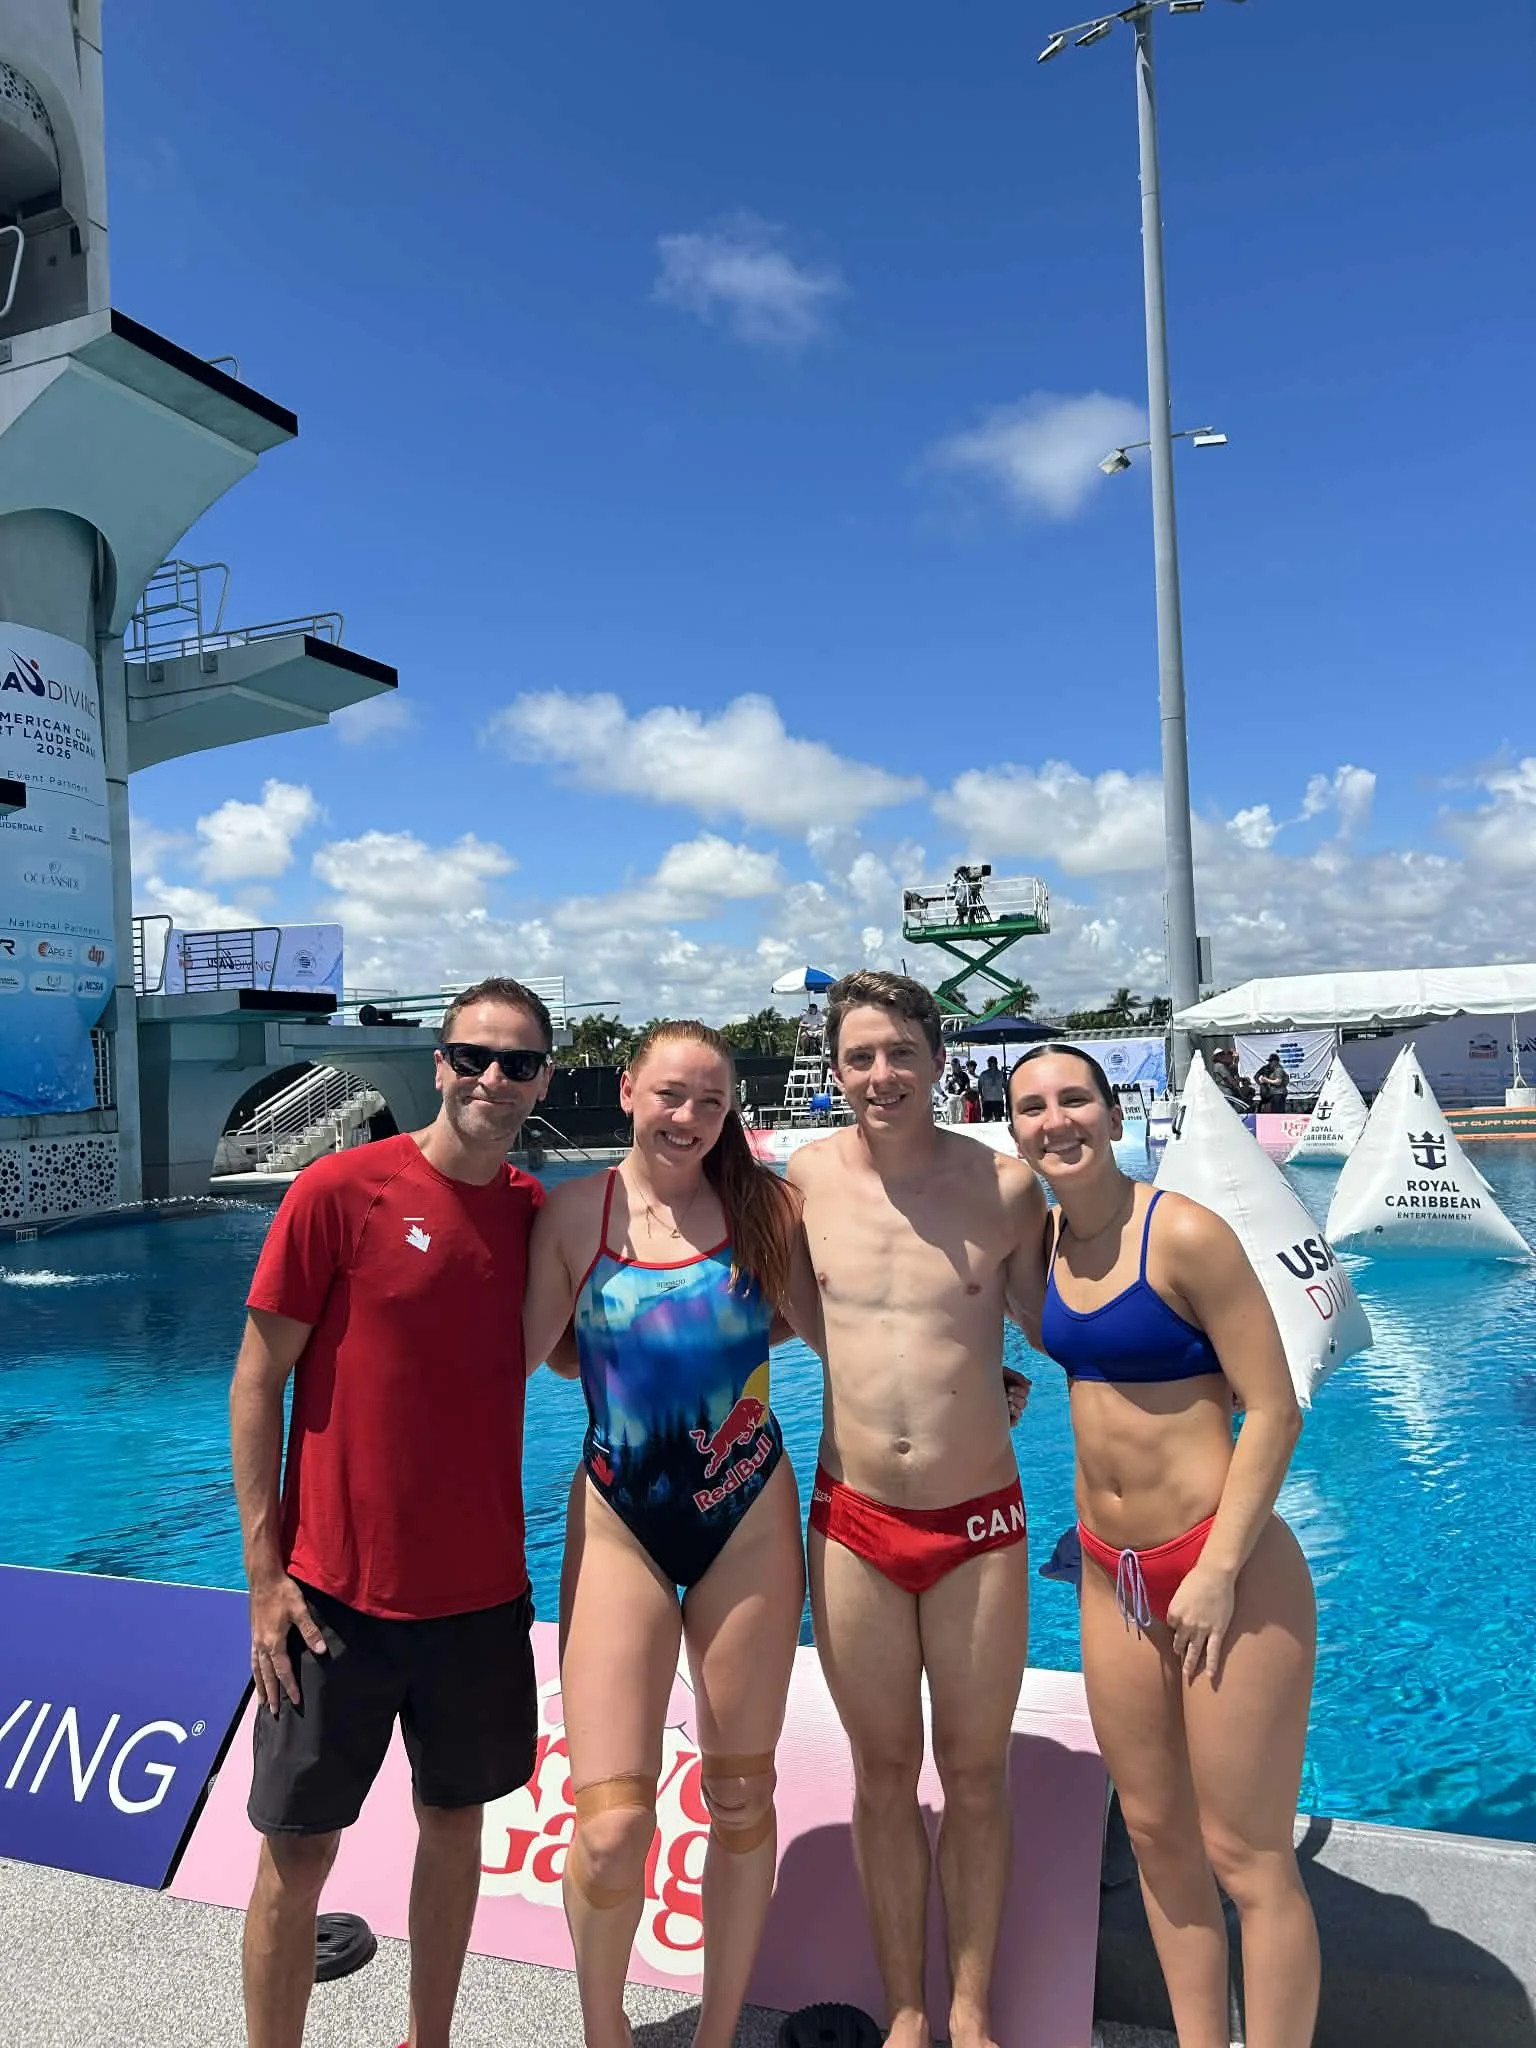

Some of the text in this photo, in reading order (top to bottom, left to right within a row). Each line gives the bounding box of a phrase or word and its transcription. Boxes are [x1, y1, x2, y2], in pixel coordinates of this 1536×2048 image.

[36, 743, 72, 760] 2026
[7, 770, 44, 783] Event
[9, 916, 61, 930] National
[235, 959, 273, 972] DIVNG
[1407, 1180, 1460, 1193] ROYAL
[1385, 1195, 1481, 1209] CARIBBEAN
[1397, 1211, 1474, 1222] ENTERTAINMENT
